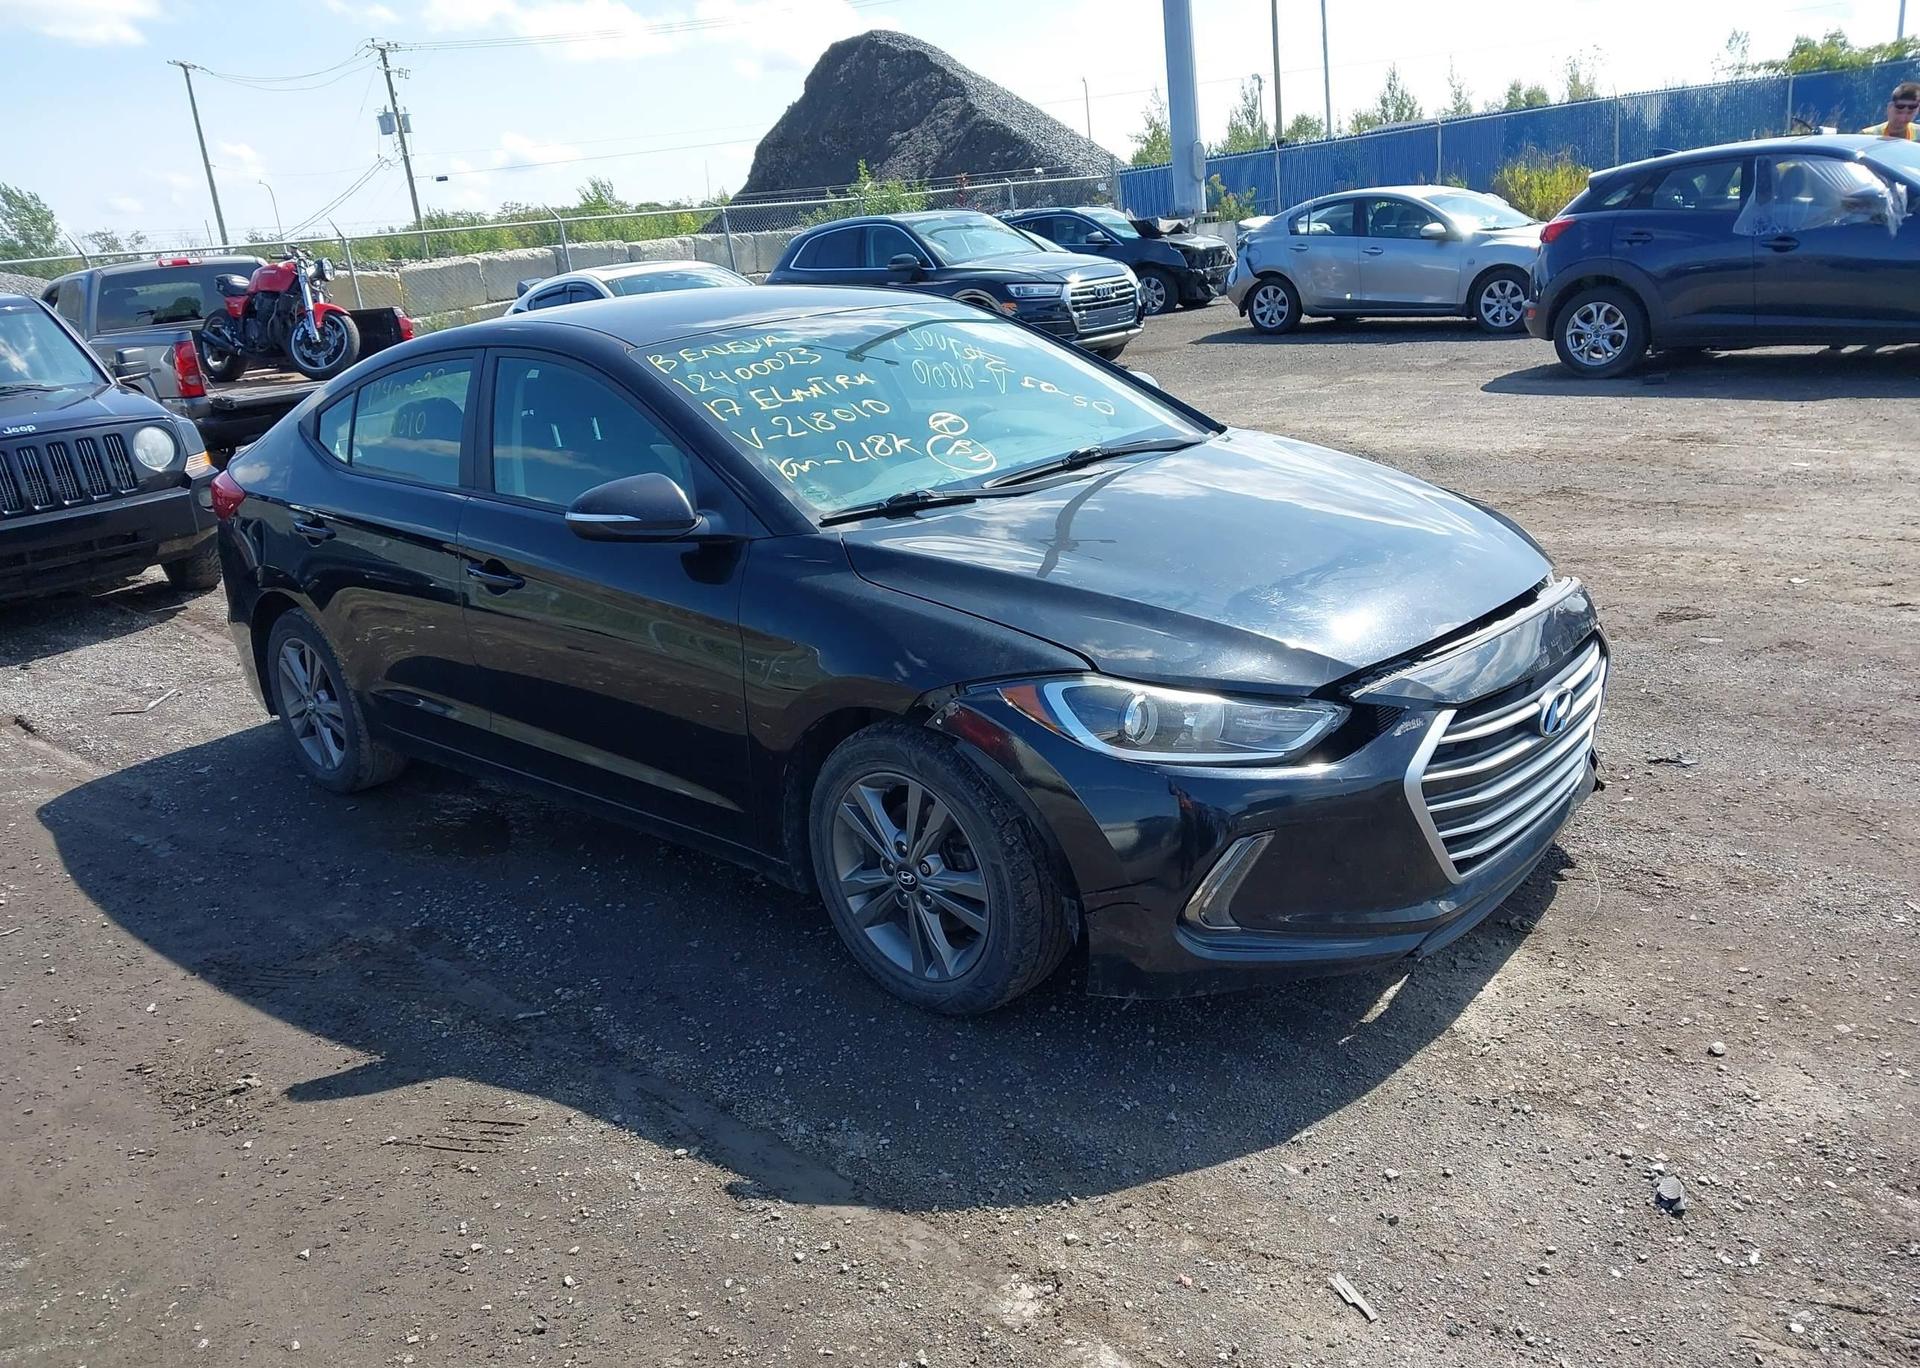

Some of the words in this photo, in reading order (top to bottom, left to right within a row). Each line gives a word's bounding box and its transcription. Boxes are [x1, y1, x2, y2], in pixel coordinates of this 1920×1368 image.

[647, 335, 785, 374] BENEVA
[673, 348, 822, 394] 12400023
[702, 398, 743, 421] 17
[3, 425, 36, 434] Jeep
